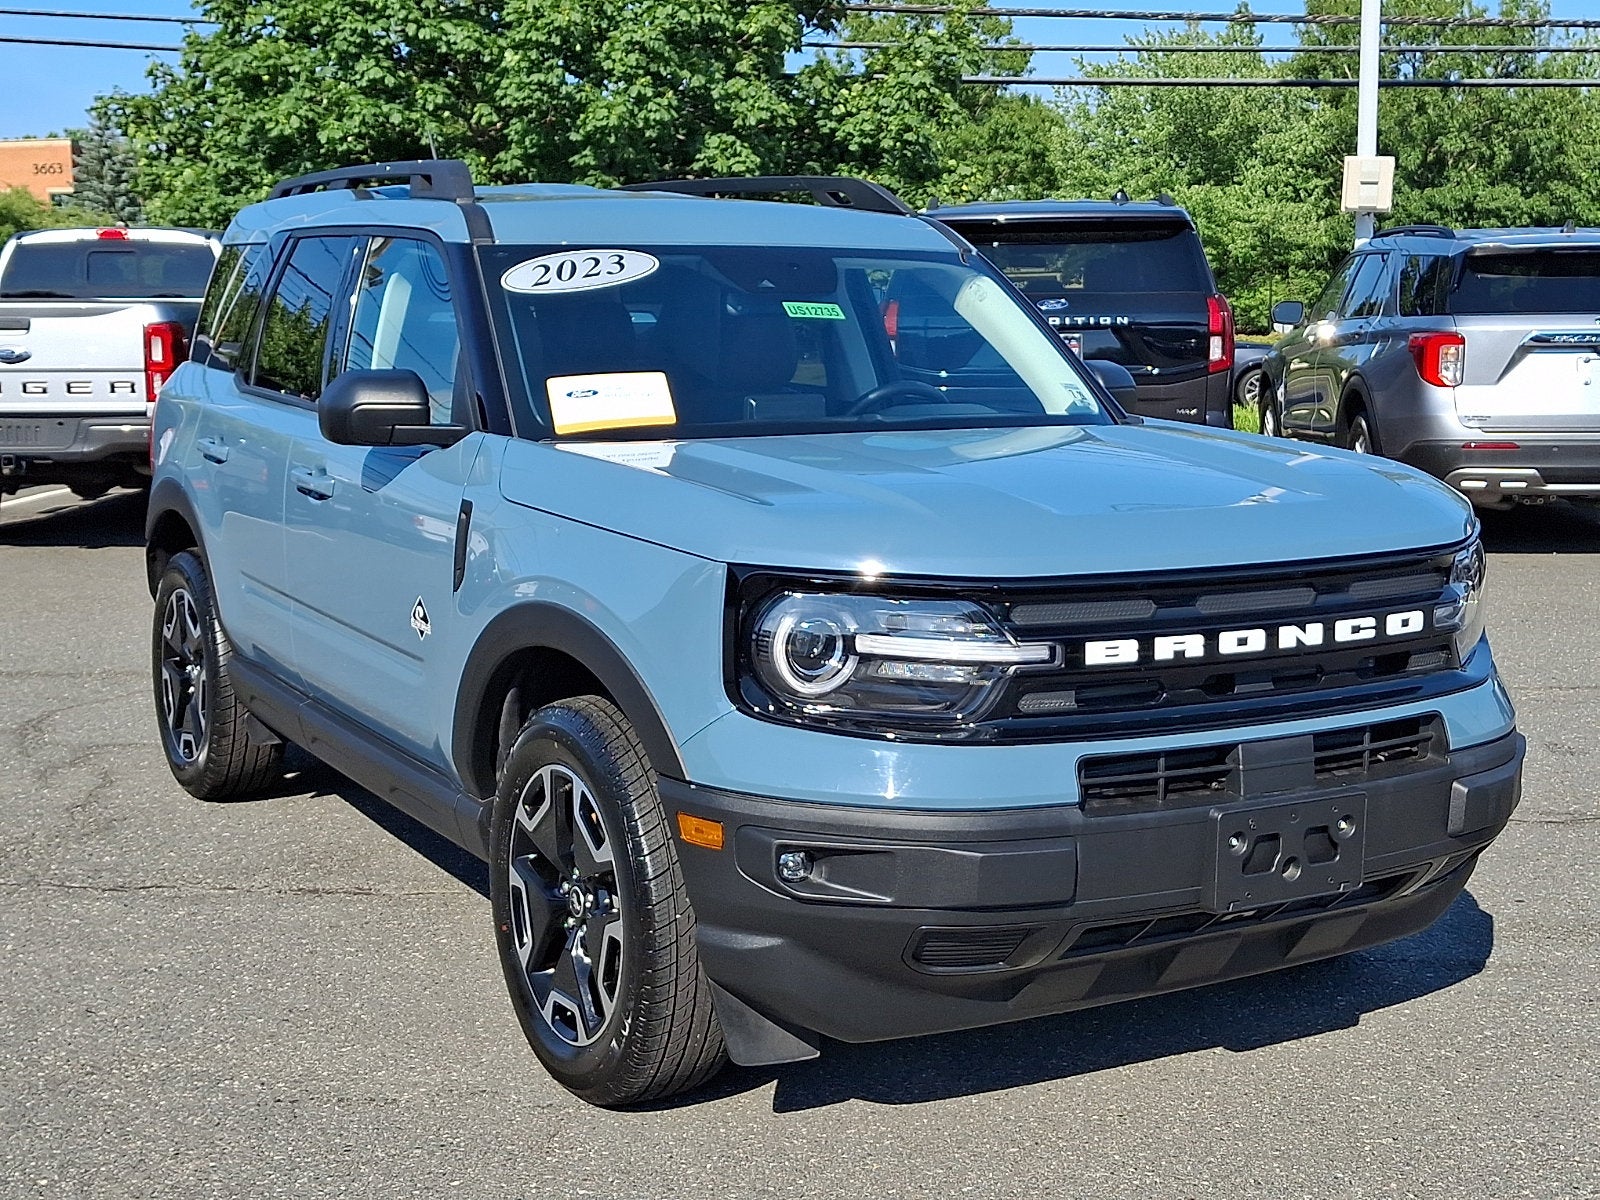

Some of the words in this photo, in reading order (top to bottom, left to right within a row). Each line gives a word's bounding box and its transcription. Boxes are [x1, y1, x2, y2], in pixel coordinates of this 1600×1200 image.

[32, 162, 63, 175] 3663
[531, 253, 625, 288] 2023
[787, 305, 840, 317] US12735
[1048, 316, 1129, 325] DITION
[1084, 610, 1425, 666] BRONCO
